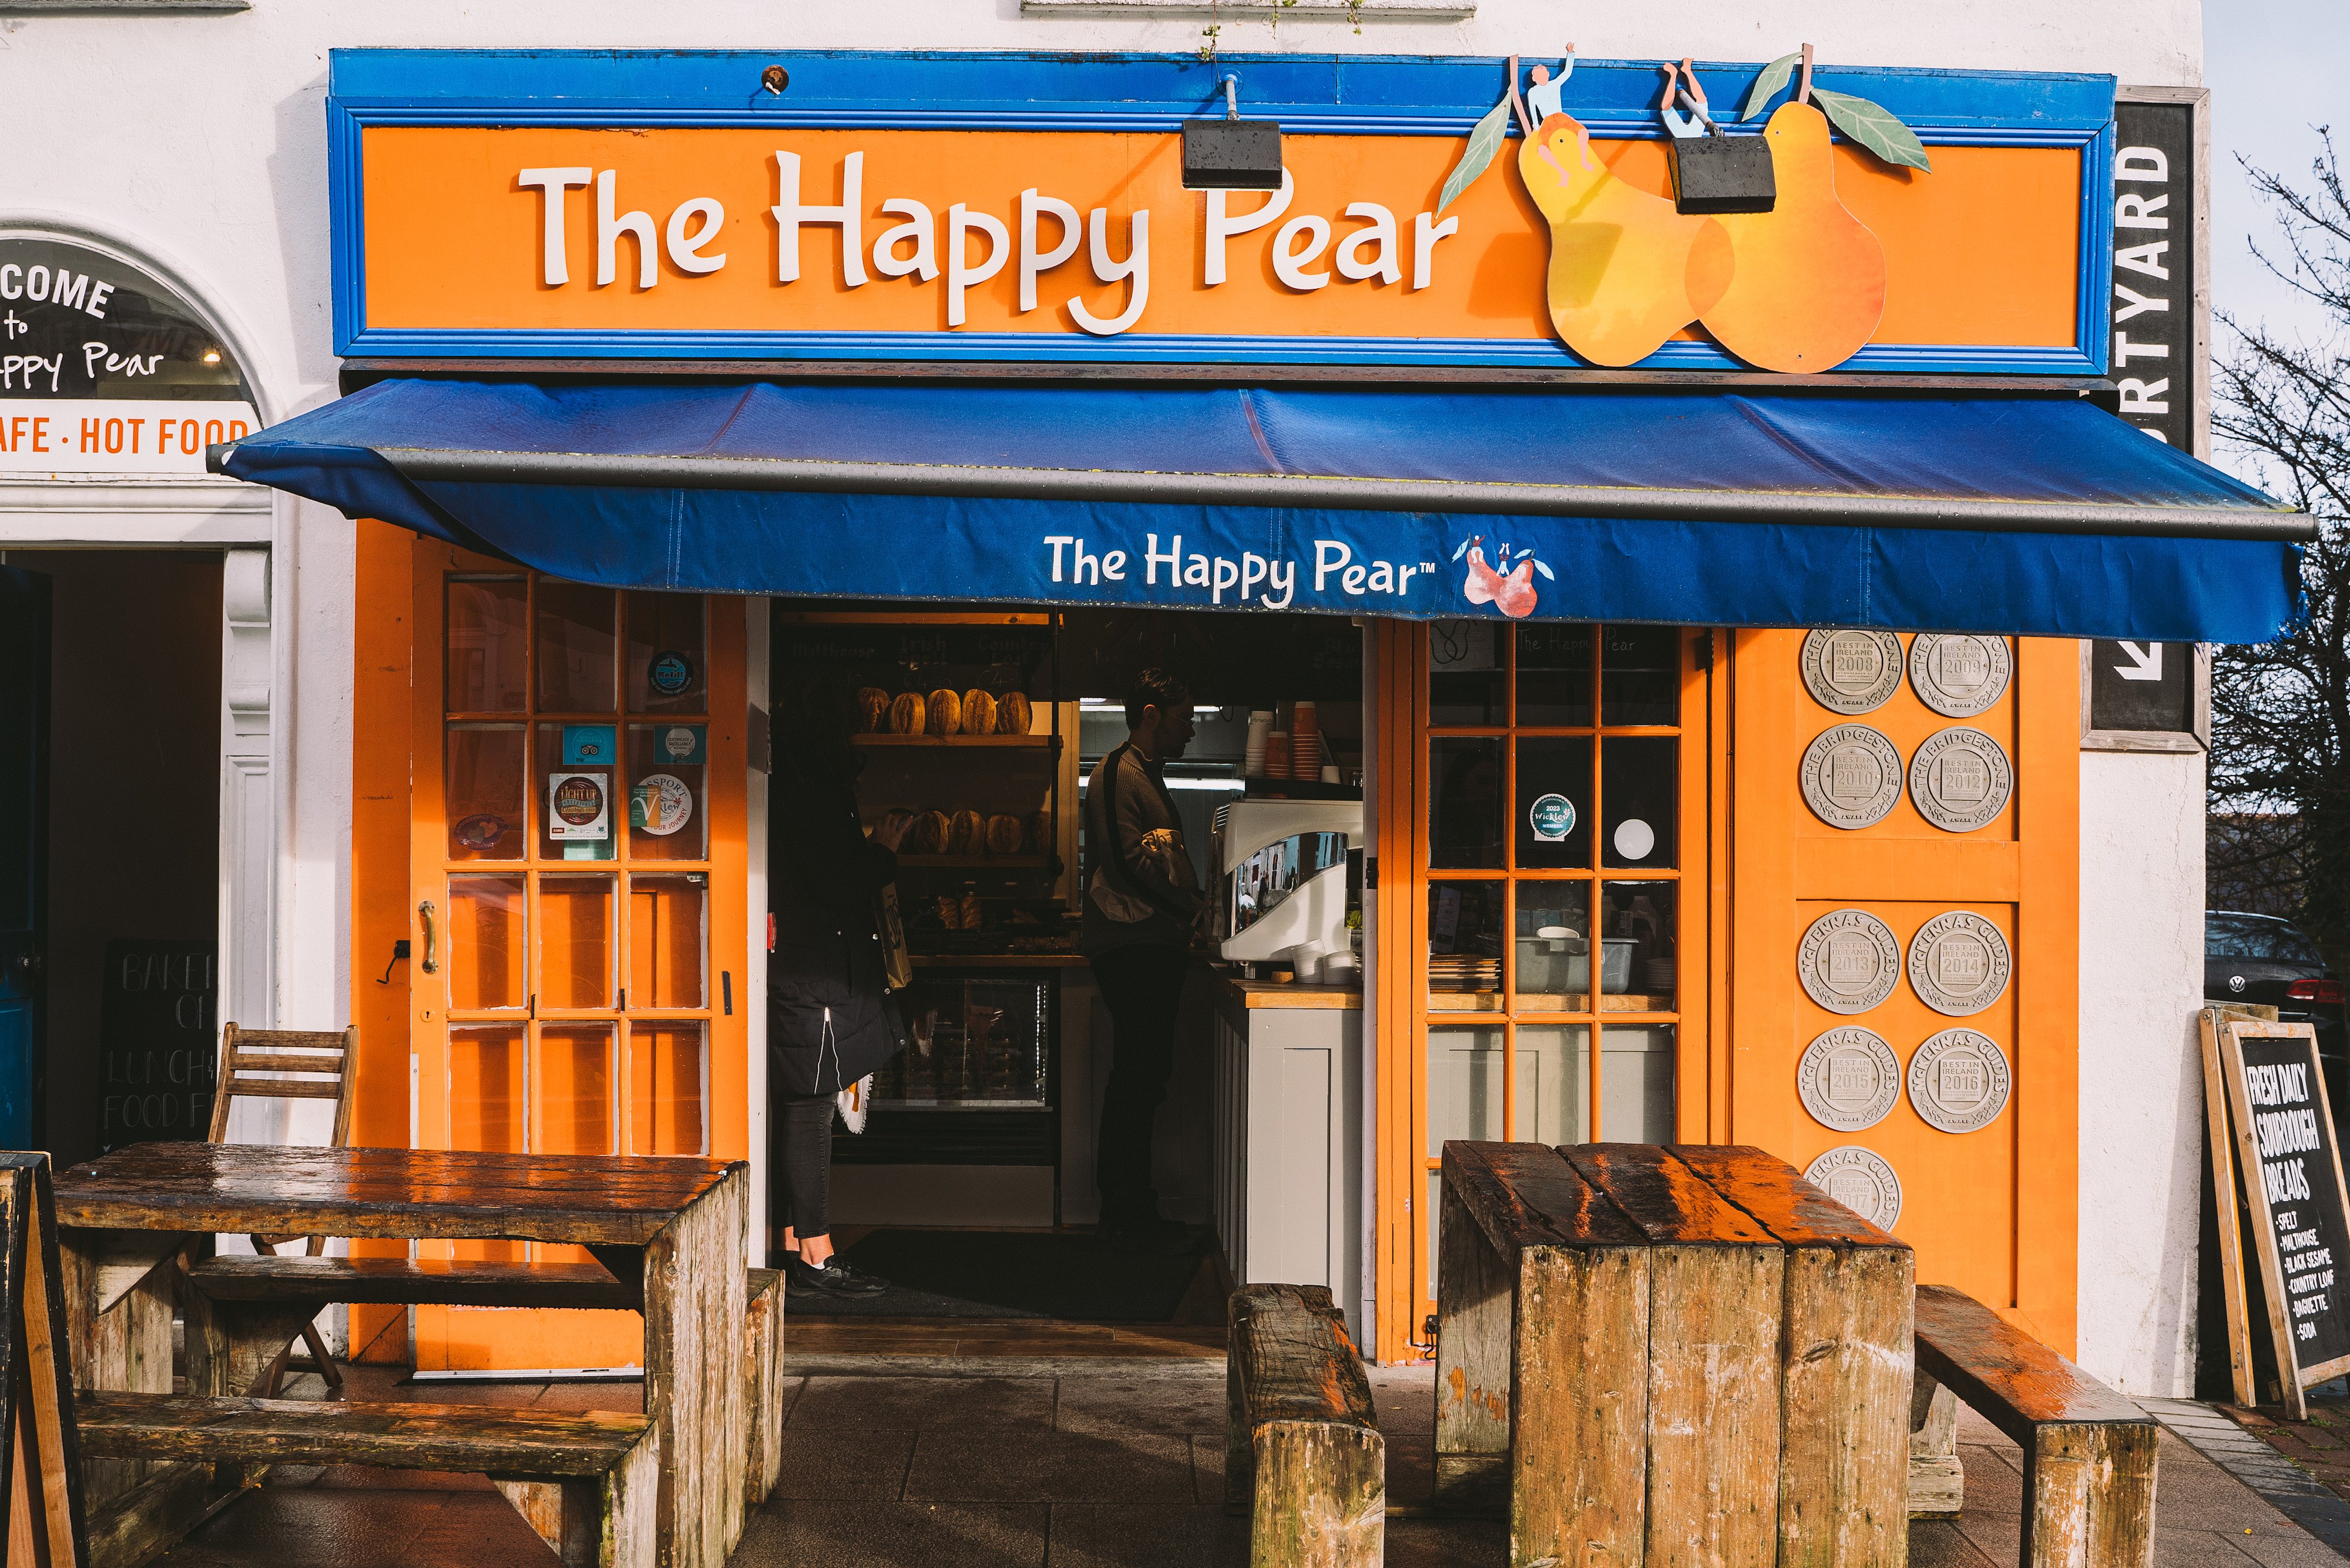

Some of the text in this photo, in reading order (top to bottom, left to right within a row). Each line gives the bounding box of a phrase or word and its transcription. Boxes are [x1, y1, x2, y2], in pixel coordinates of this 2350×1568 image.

[518, 150, 1459, 335] The Happy Pear
[2115, 146, 2169, 444] RTYARD
[4, 310, 28, 340] to
[0, 352, 63, 392] ppy
[82, 341, 164, 378] Pear
[80, 418, 145, 454] HOT
[159, 419, 248, 455] FOOD
[1043, 536, 1126, 586] The
[1144, 533, 1294, 609] Happy
[1807, 639, 1821, 670] THE
[1837, 657, 1873, 671] 2008
[1914, 642, 1928, 674] THE
[1945, 660, 1980, 674] 2009
[1806, 729, 1898, 786] THE BRIDGESTONE
[1915, 733, 2007, 788] THE BRIDGESTONE
[1837, 771, 1872, 785] 2010
[1946, 775, 1980, 789] 2012
[586, 789, 597, 800] UP
[669, 808, 687, 829] JOURNEY
[1535, 812, 1570, 824] Wicklow
[1834, 957, 1868, 971] 2013
[1943, 959, 1978, 973] 2014
[176, 993, 217, 1029] OP
[108, 1049, 204, 1086] LUNCH
[1834, 1075, 1868, 1088] 2015
[1944, 1076, 1978, 1090] 2016
[2246, 1062, 2309, 1106] FRESH DAILY
[104, 1093, 179, 1129] FOOD
[2256, 1109, 2320, 1157] SOURDOUGH
[2264, 1157, 2311, 1204] BREADS
[2278, 1211, 2298, 1231] SPELT
[2281, 1228, 2319, 1252] MALTHOUSE
[2285, 1247, 2332, 1274] BLACK SESAME
[2289, 1269, 2334, 1294] COUNTRY LOAF
[2294, 1294, 2328, 1318] BAGUETTE
[2298, 1321, 2317, 1341] SODA
